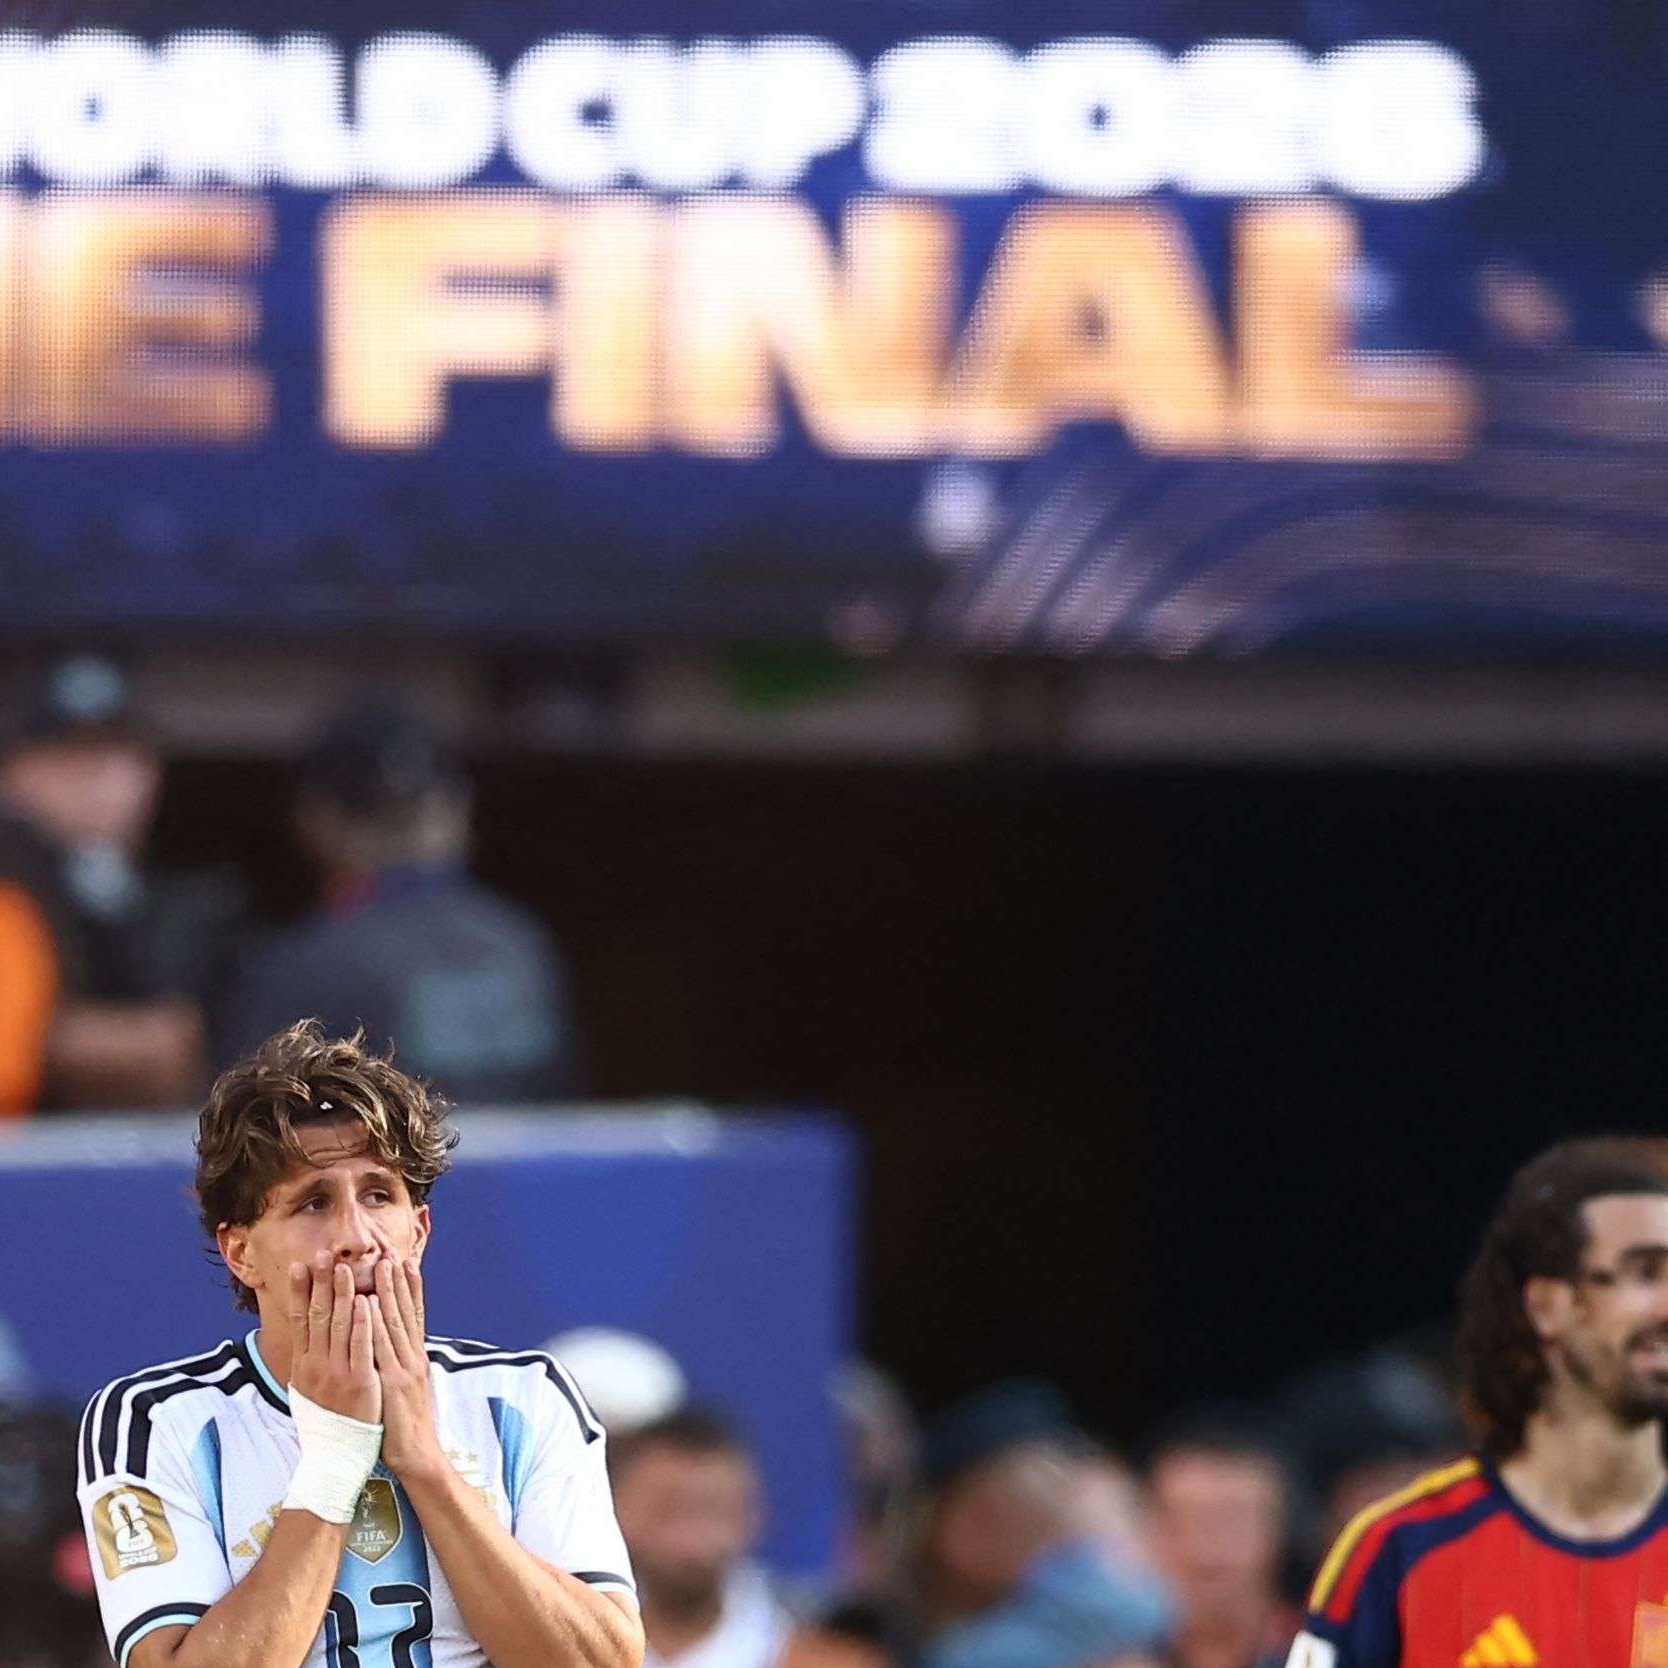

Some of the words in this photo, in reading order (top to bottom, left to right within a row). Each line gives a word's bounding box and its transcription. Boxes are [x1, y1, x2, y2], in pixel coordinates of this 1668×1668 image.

[504, 32, 865, 194] CUP
[862, 36, 1489, 200] 2026
[316, 190, 1482, 460] FINAL
[355, 1529, 387, 1543] FIFA
